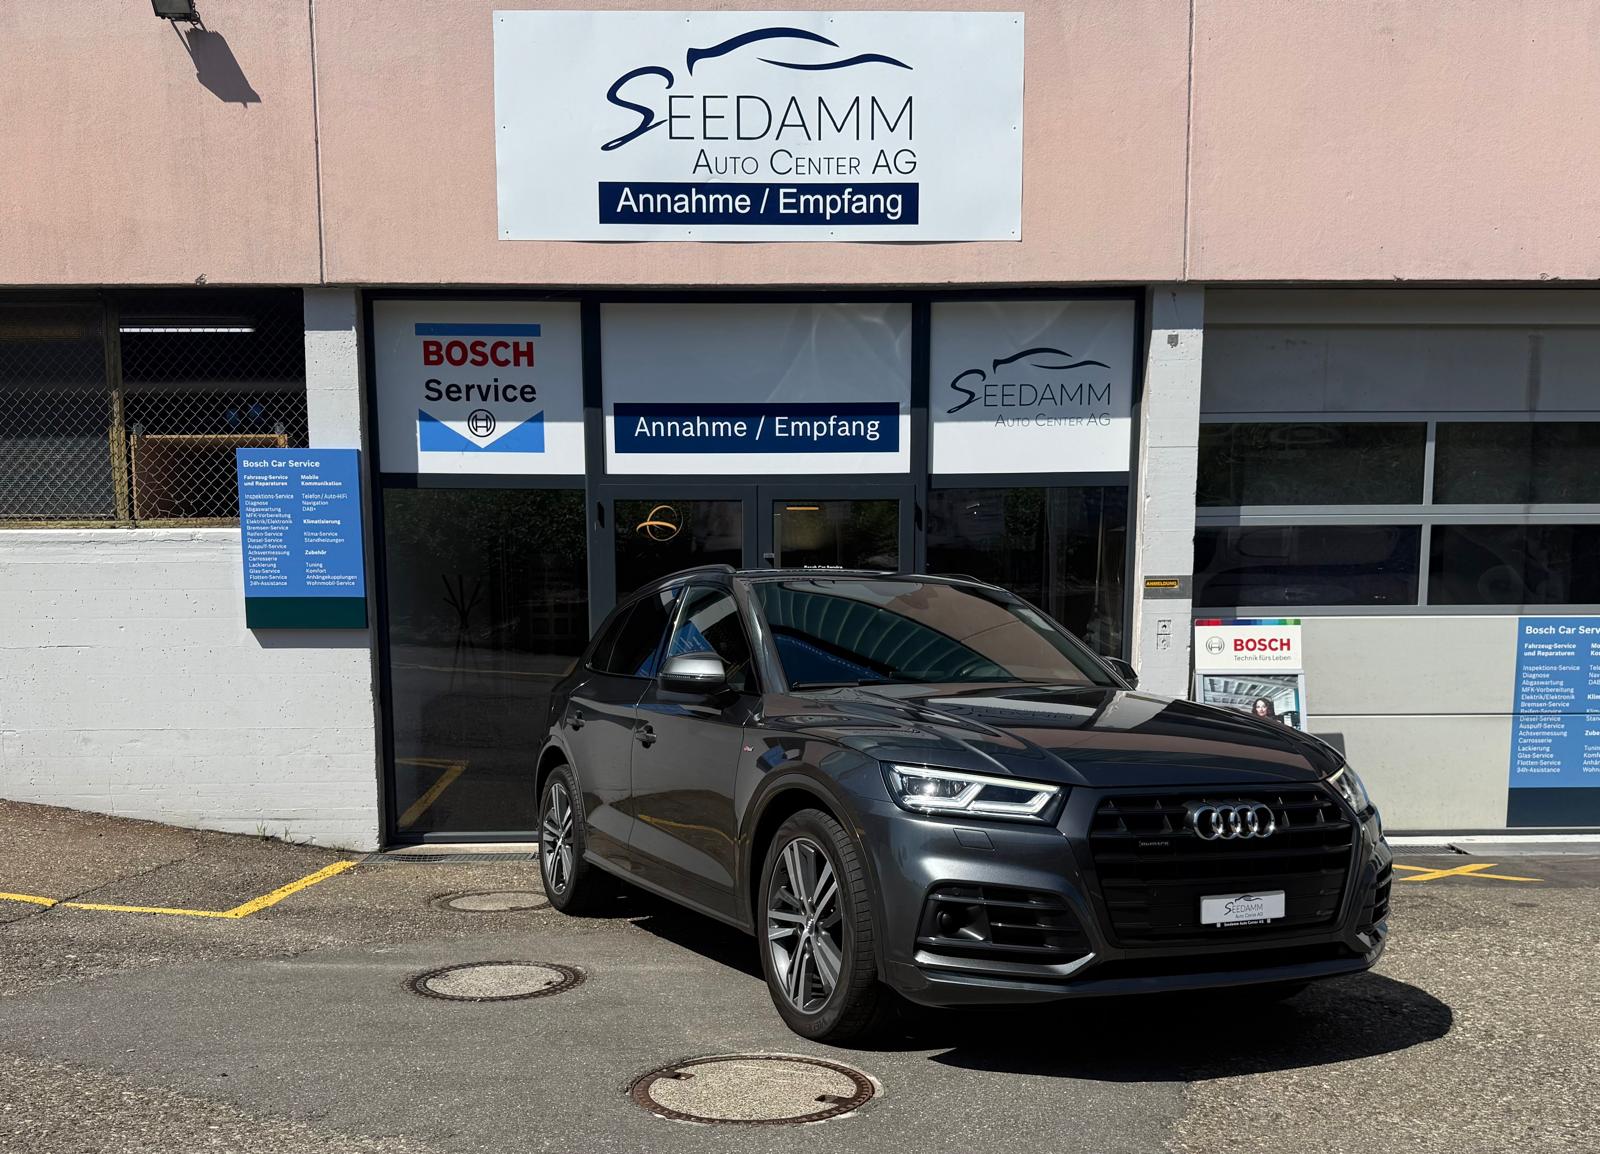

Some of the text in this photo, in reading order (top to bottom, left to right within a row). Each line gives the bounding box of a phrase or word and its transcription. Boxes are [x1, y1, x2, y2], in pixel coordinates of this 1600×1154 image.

[600, 66, 914, 151] SEEDAMM
[872, 149, 918, 175] AG
[617, 187, 903, 219] Annahme / Empfang
[422, 340, 535, 367] BOSCH
[424, 378, 537, 402] Service
[946, 368, 1111, 414] SEEDAMM
[634, 415, 880, 441] Annahme / Empfang
[1087, 412, 1111, 426] AG
[1525, 626, 1555, 634] Bosch
[1559, 626, 1576, 634] Car
[1233, 638, 1291, 651] BOSCH
[1224, 901, 1263, 916] SEEDAMM
